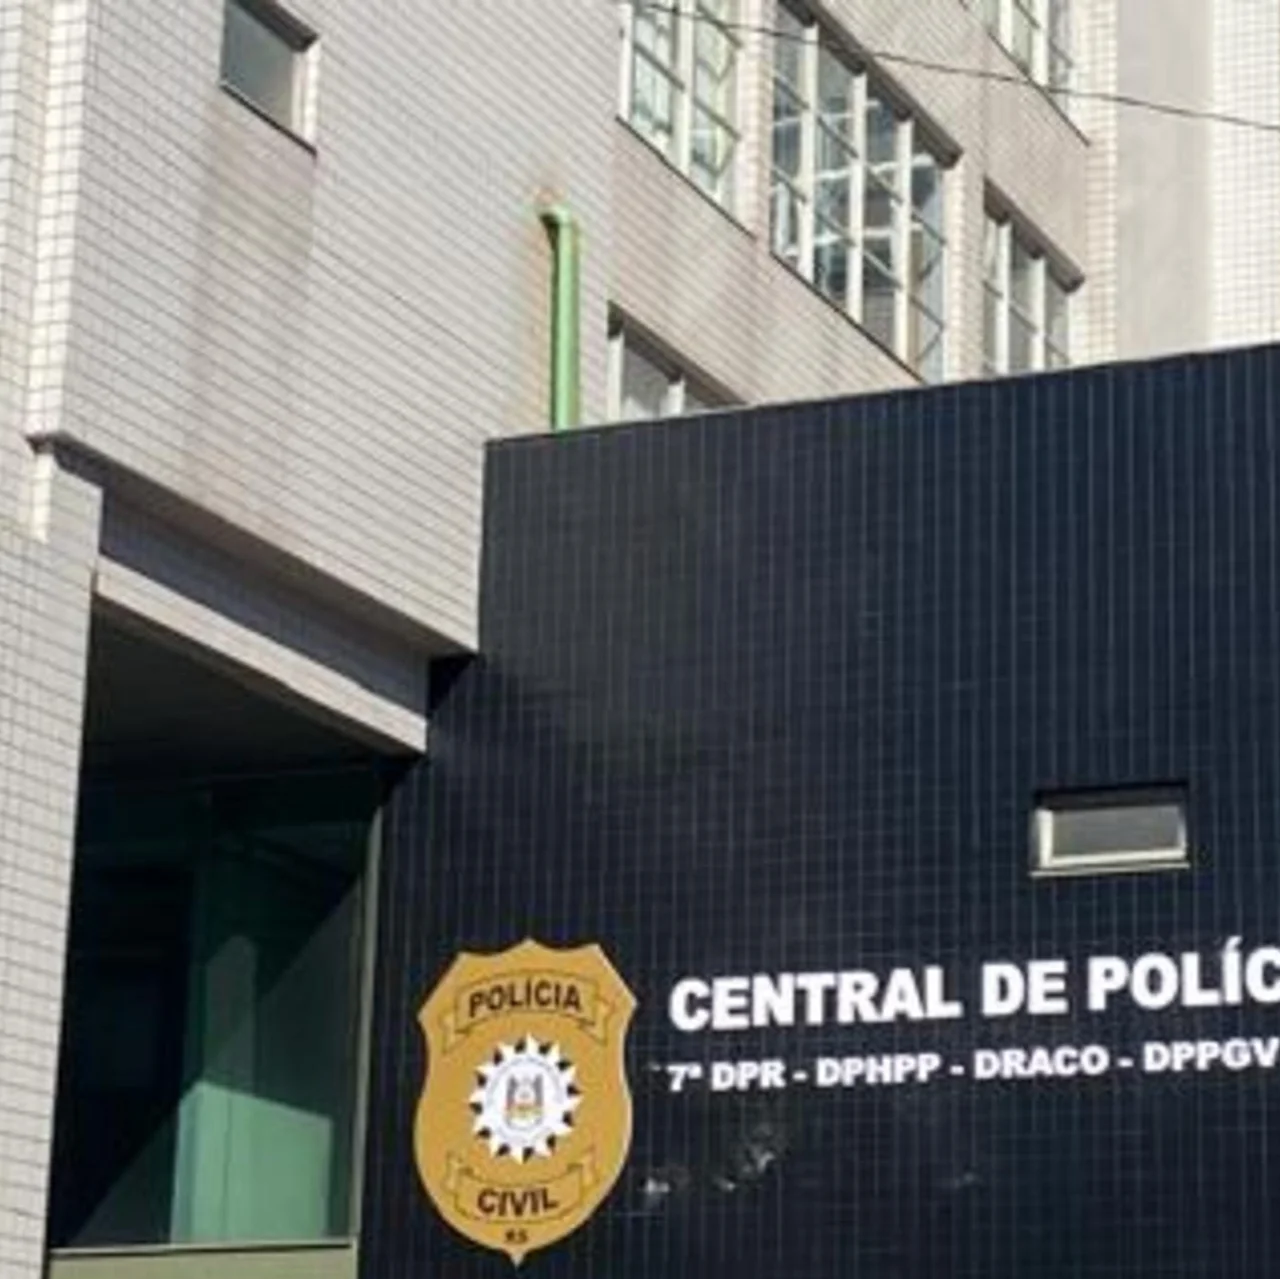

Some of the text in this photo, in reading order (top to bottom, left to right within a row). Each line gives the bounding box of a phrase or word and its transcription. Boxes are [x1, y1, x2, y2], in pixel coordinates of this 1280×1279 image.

[669, 966, 963, 1031] CENTRAL
[982, 959, 1068, 1016] DE
[711, 1058, 787, 1092] DPR
[817, 1052, 942, 1087] DPHPP
[974, 1045, 1109, 1080] DRACO
[1144, 1037, 1280, 1072] DPPGV
[477, 1186, 560, 1217] CIVIL
